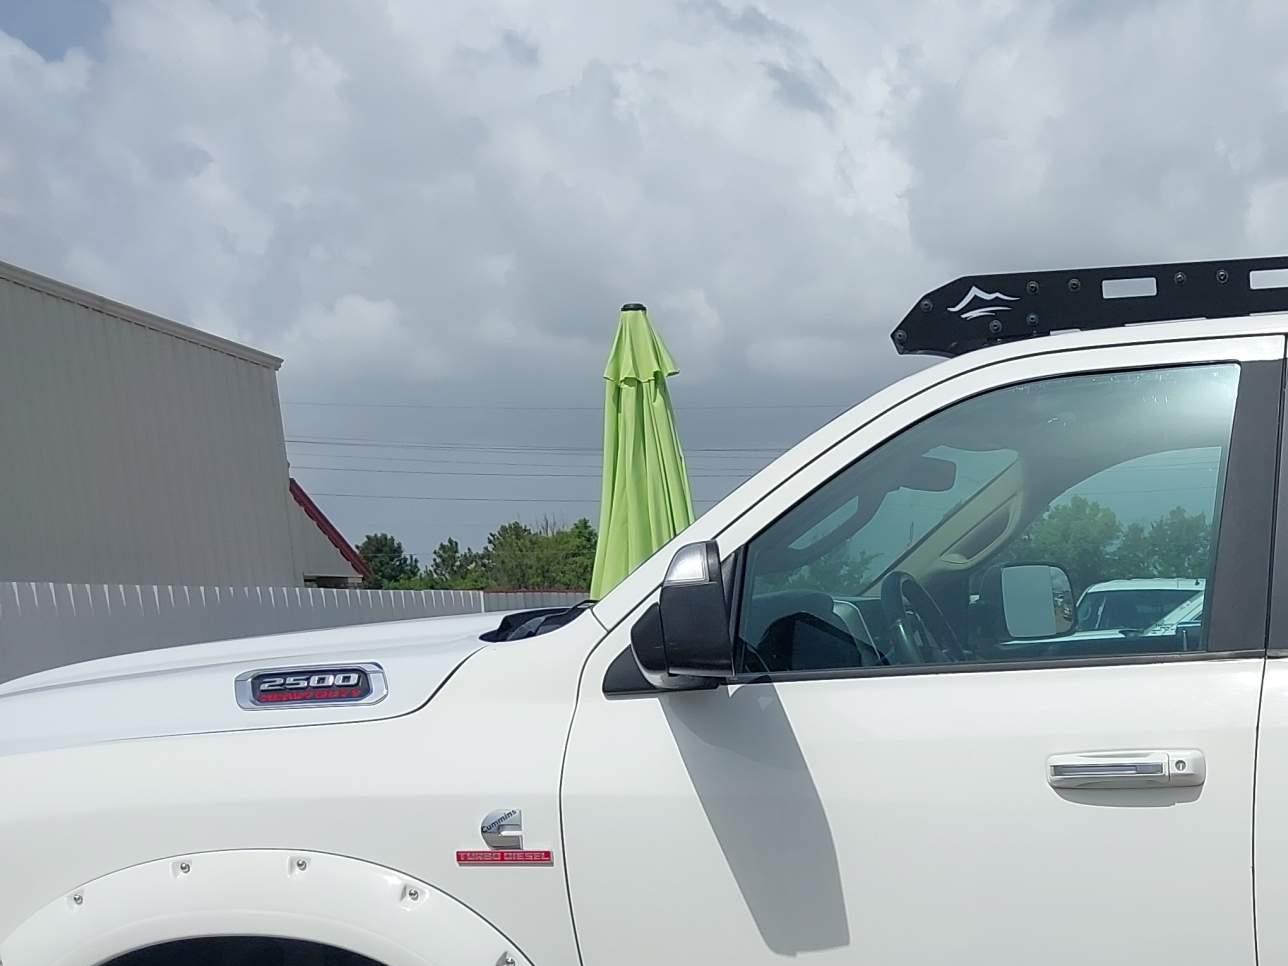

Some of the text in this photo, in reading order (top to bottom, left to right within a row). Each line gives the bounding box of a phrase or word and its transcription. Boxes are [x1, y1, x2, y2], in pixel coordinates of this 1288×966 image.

[259, 673, 360, 692] 2500
[481, 809, 517, 833] Cummins
[458, 852, 550, 861] TURBO DIESEL
